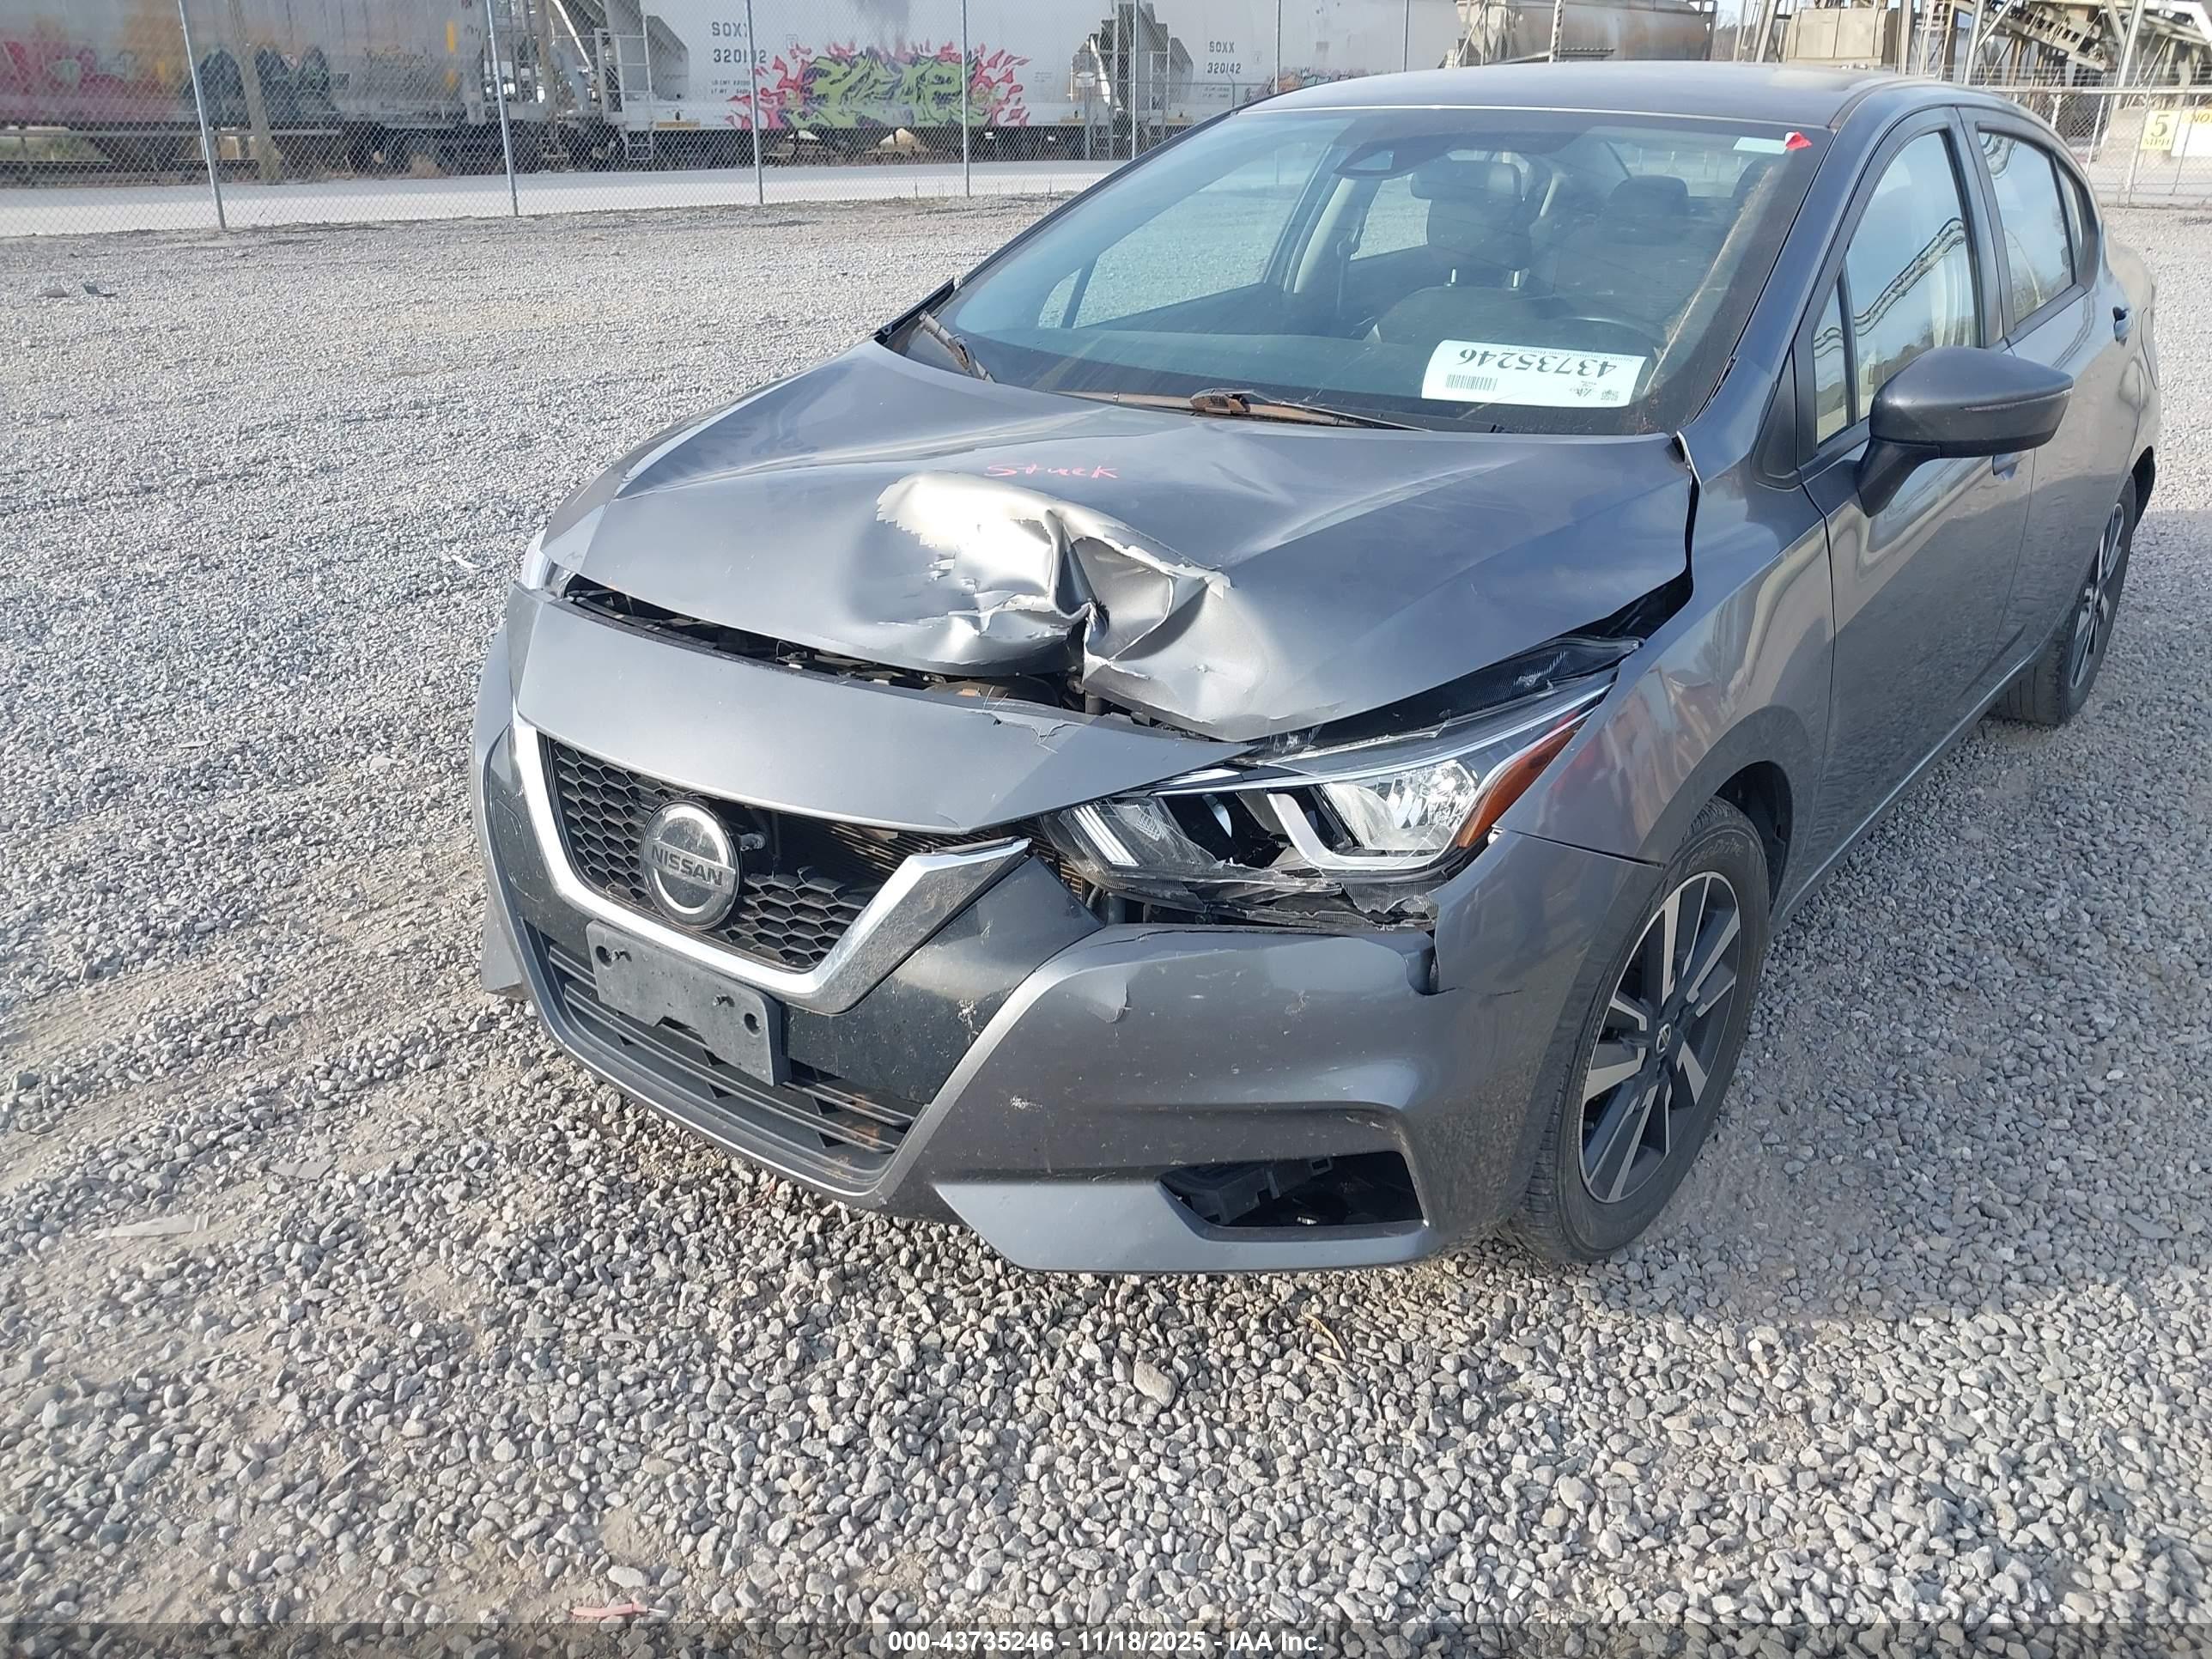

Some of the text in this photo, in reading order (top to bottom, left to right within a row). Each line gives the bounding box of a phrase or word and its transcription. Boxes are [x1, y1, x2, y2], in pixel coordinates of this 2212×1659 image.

[1209, 41, 1235, 53] SOXX
[1207, 63, 1242, 75] 320142
[2150, 114, 2170, 137] 5
[1456, 349, 1618, 379] 43735246
[652, 844, 723, 886] NISSAN
